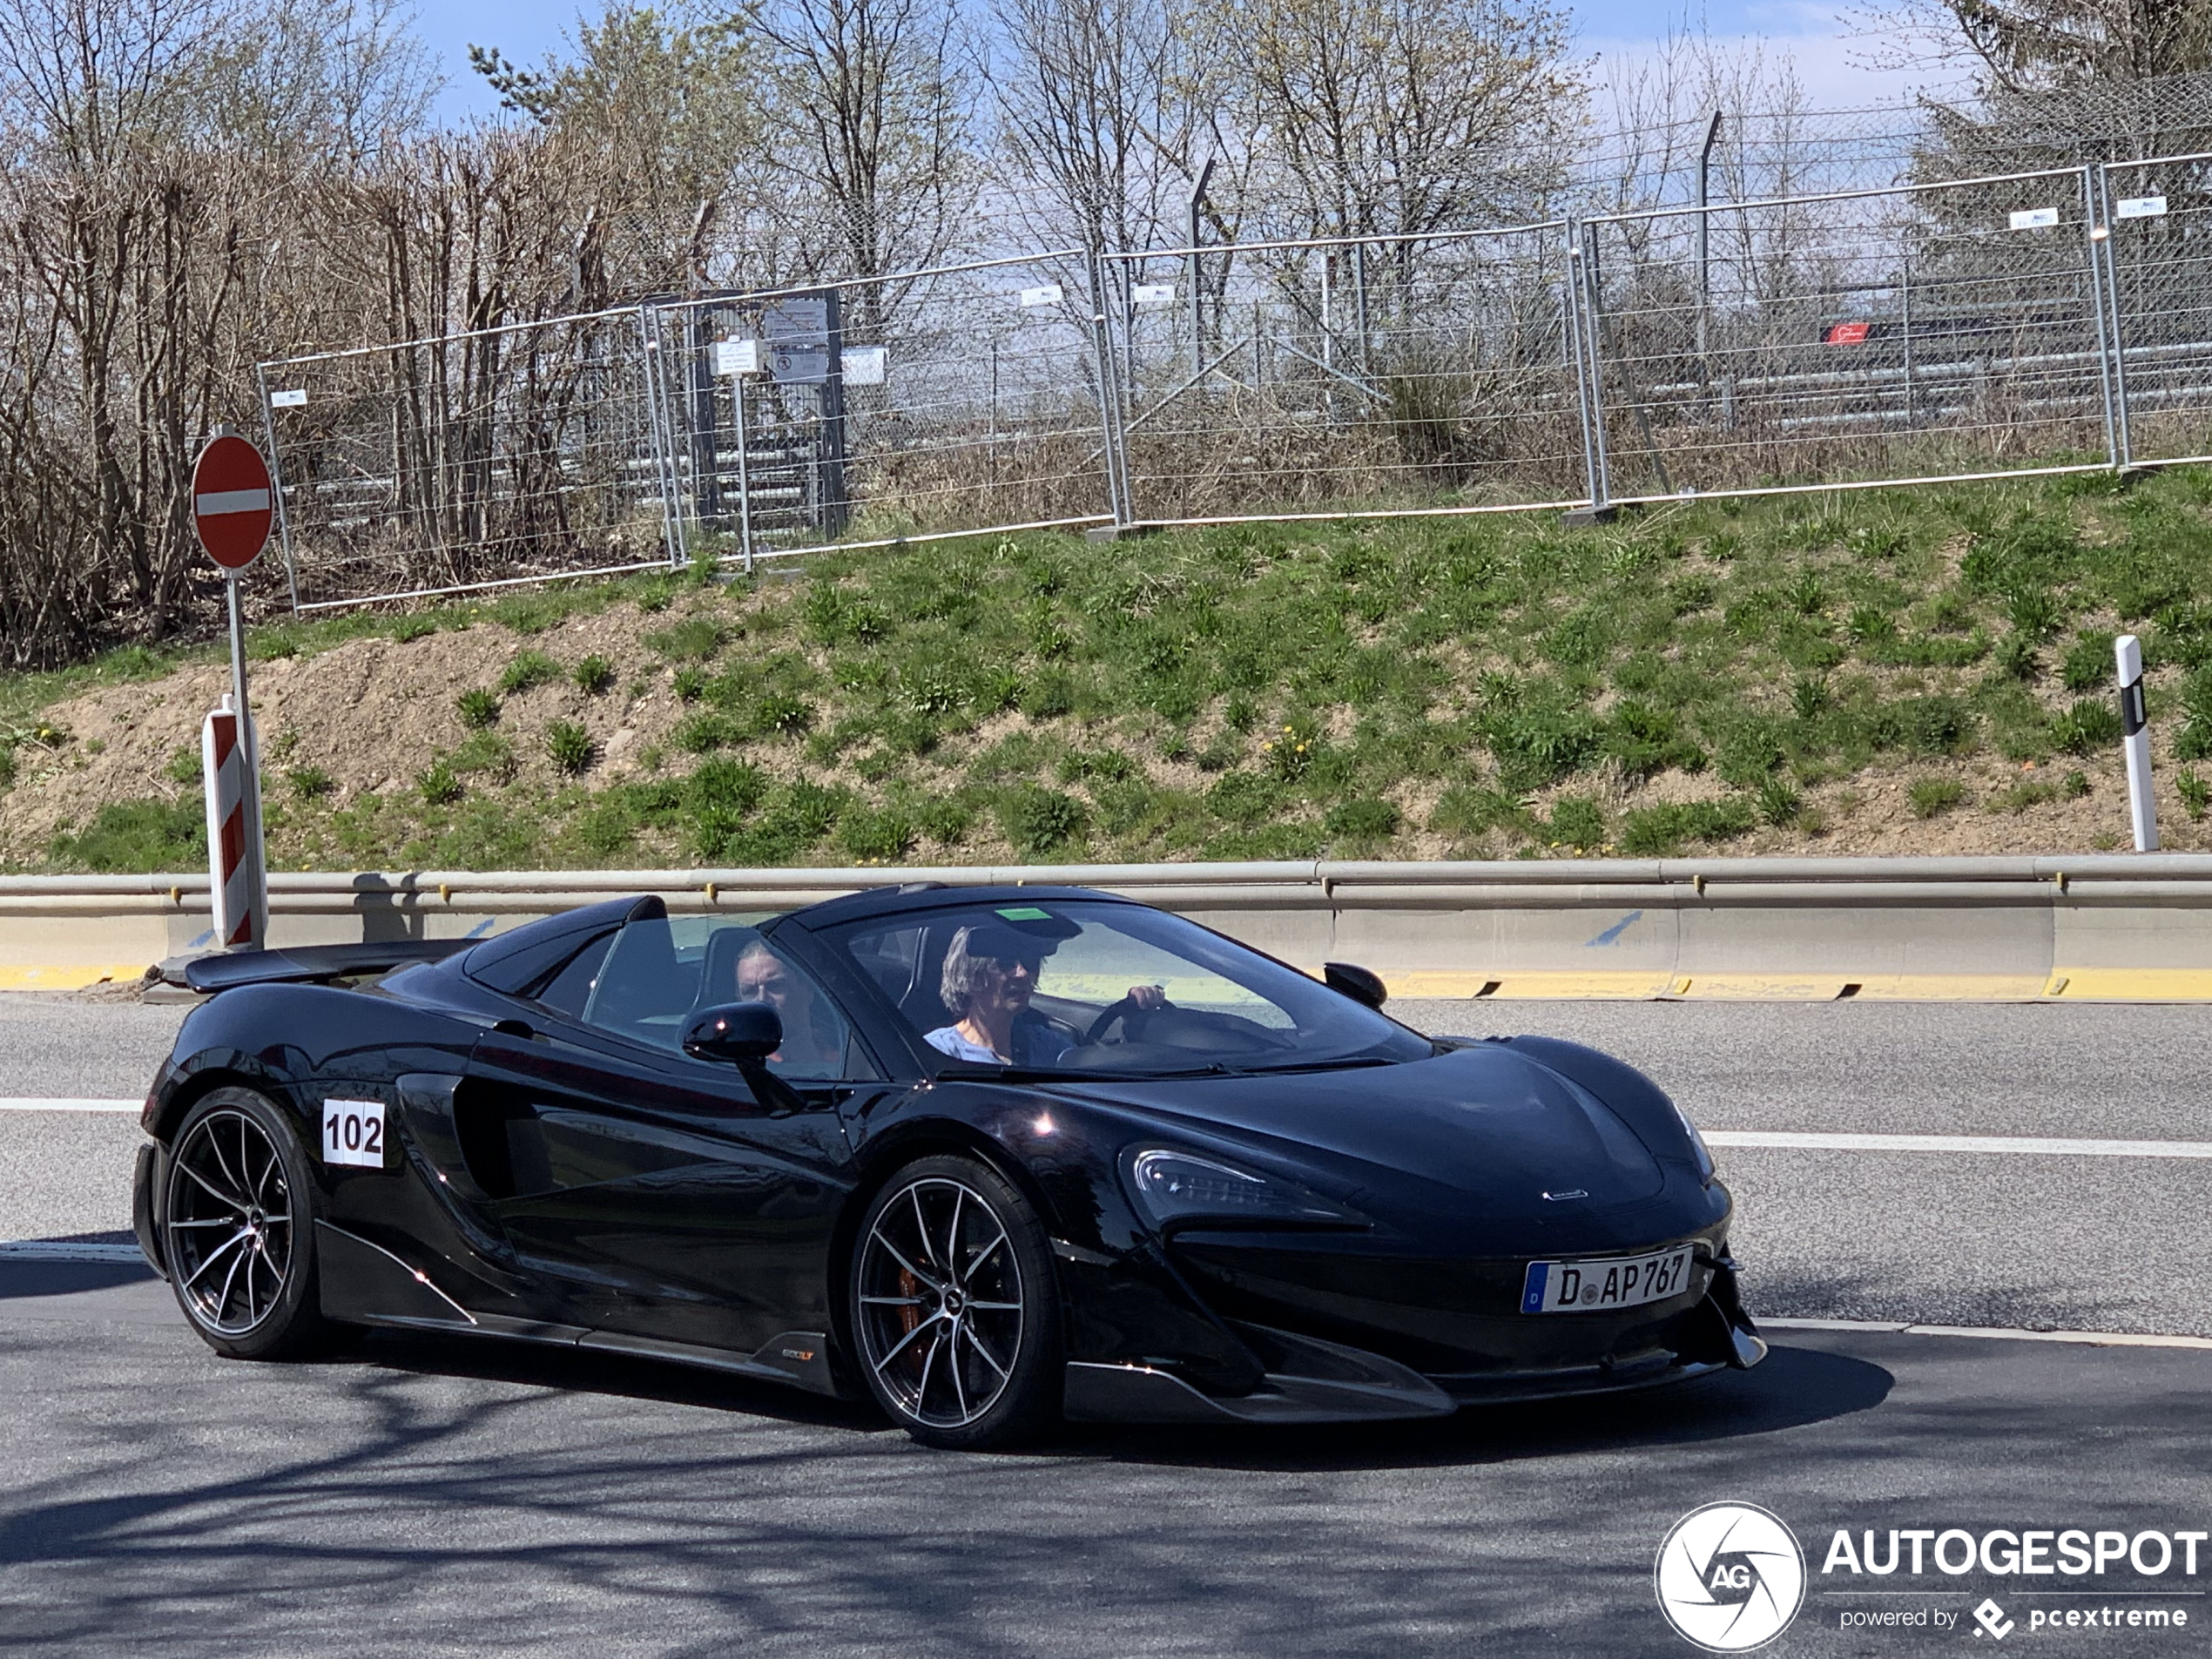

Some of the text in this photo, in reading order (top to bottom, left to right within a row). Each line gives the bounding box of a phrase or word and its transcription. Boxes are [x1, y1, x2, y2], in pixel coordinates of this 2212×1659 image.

[326, 1113, 381, 1154] 102
[1529, 1292, 1539, 1305] D
[1557, 1269, 1581, 1305] D
